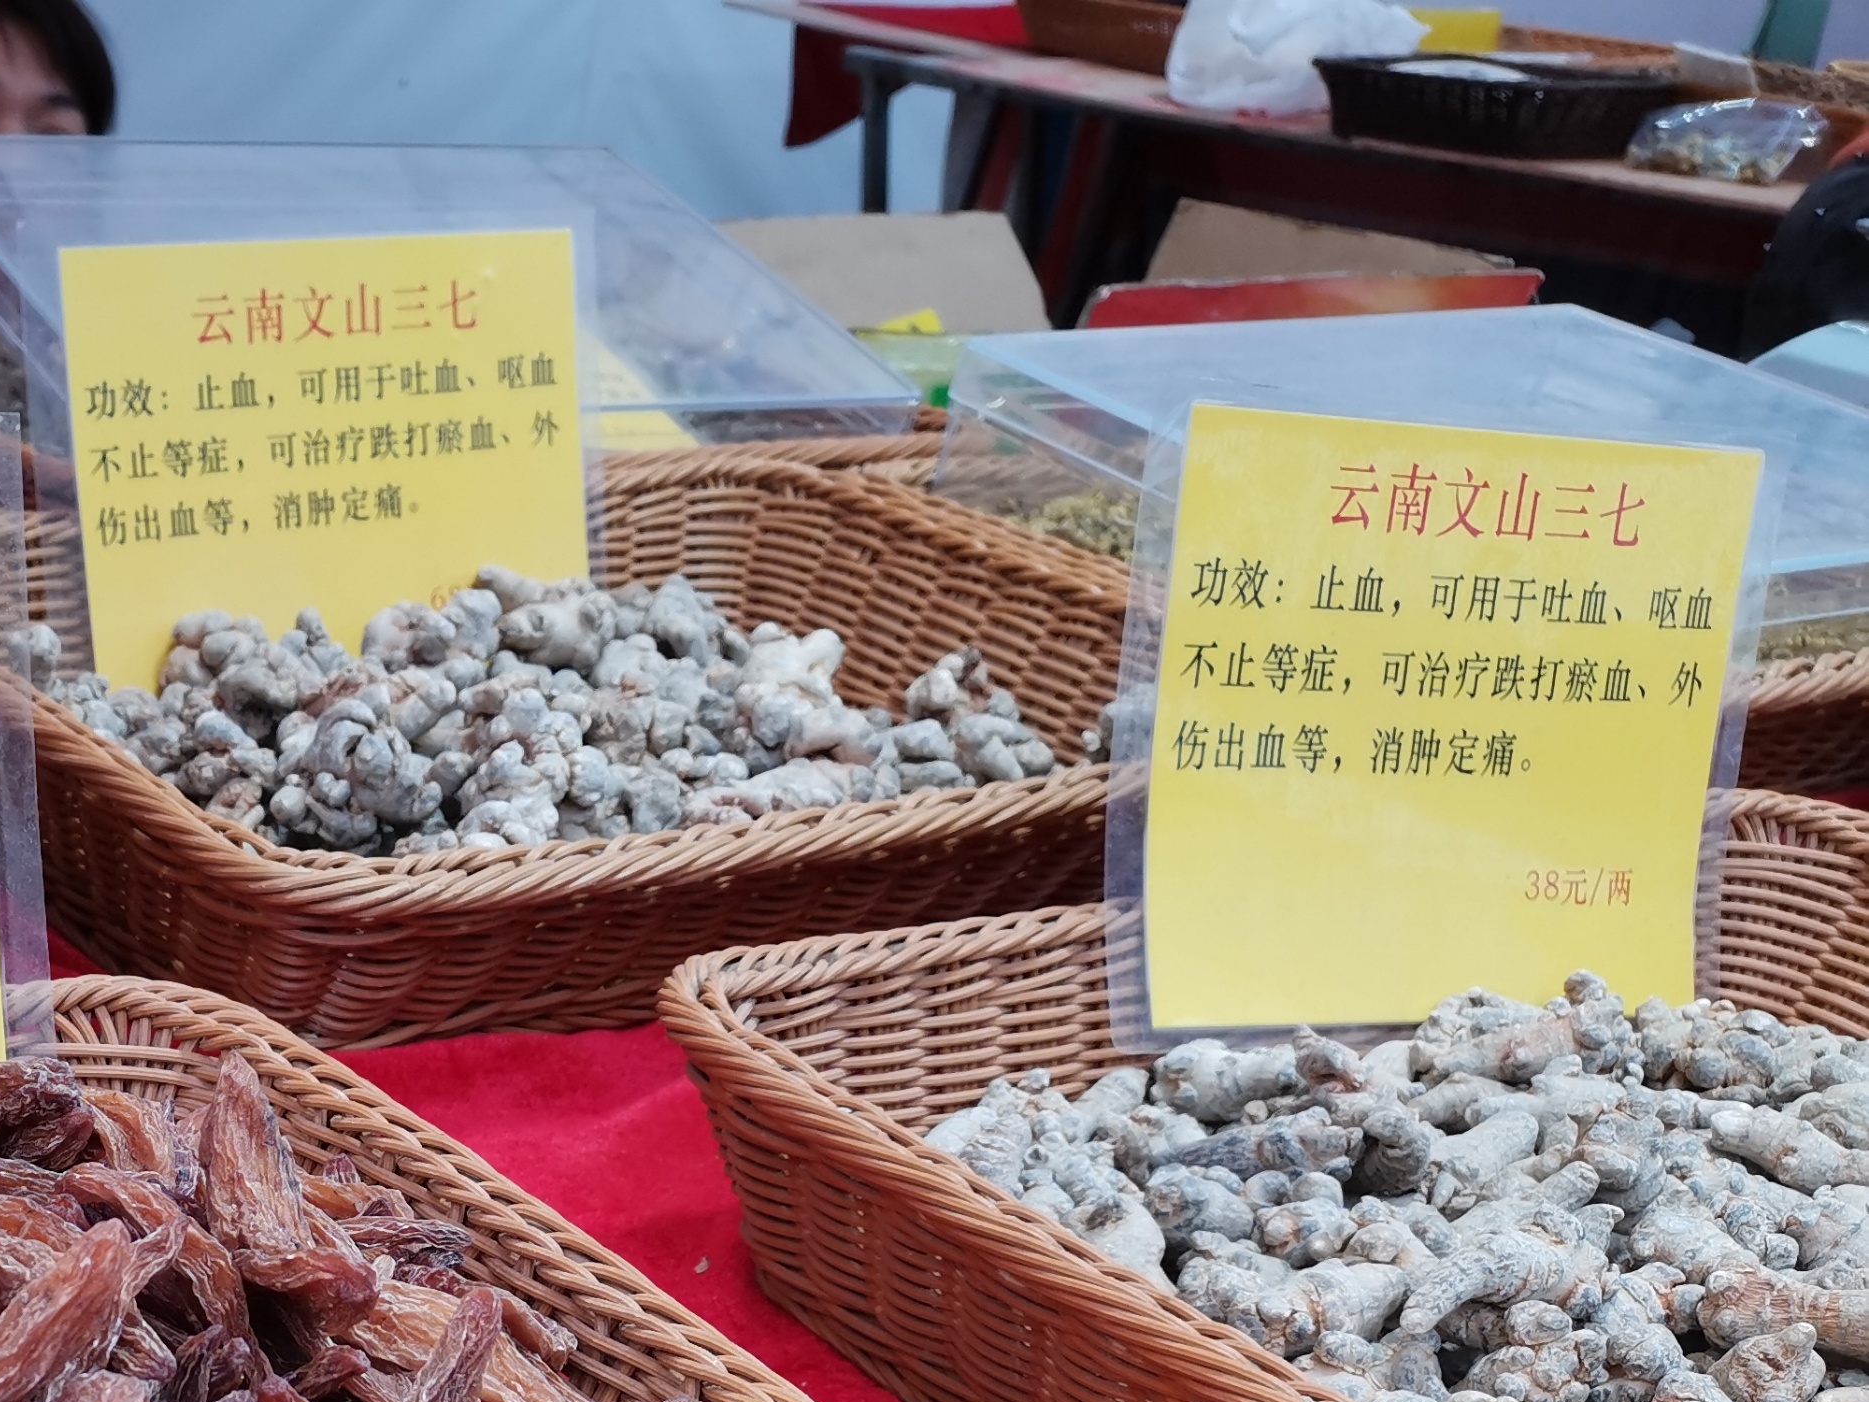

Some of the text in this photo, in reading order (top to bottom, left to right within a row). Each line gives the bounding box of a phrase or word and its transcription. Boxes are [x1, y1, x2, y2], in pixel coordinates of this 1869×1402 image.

[191, 279, 479, 344] 云南文山三七
[90, 410, 560, 482] 不止等症，可治疗跌打瘀血、外
[96, 483, 422, 547] 伤出血等，消肿定痛。
[1329, 463, 1646, 547] 云南文山三七
[1178, 641, 1703, 708] 不止等症，可治疗跌打瘀血、外
[1171, 720, 1533, 778] 伤出血等，消肿定痛。
[1524, 867, 1633, 906] 38元/两
